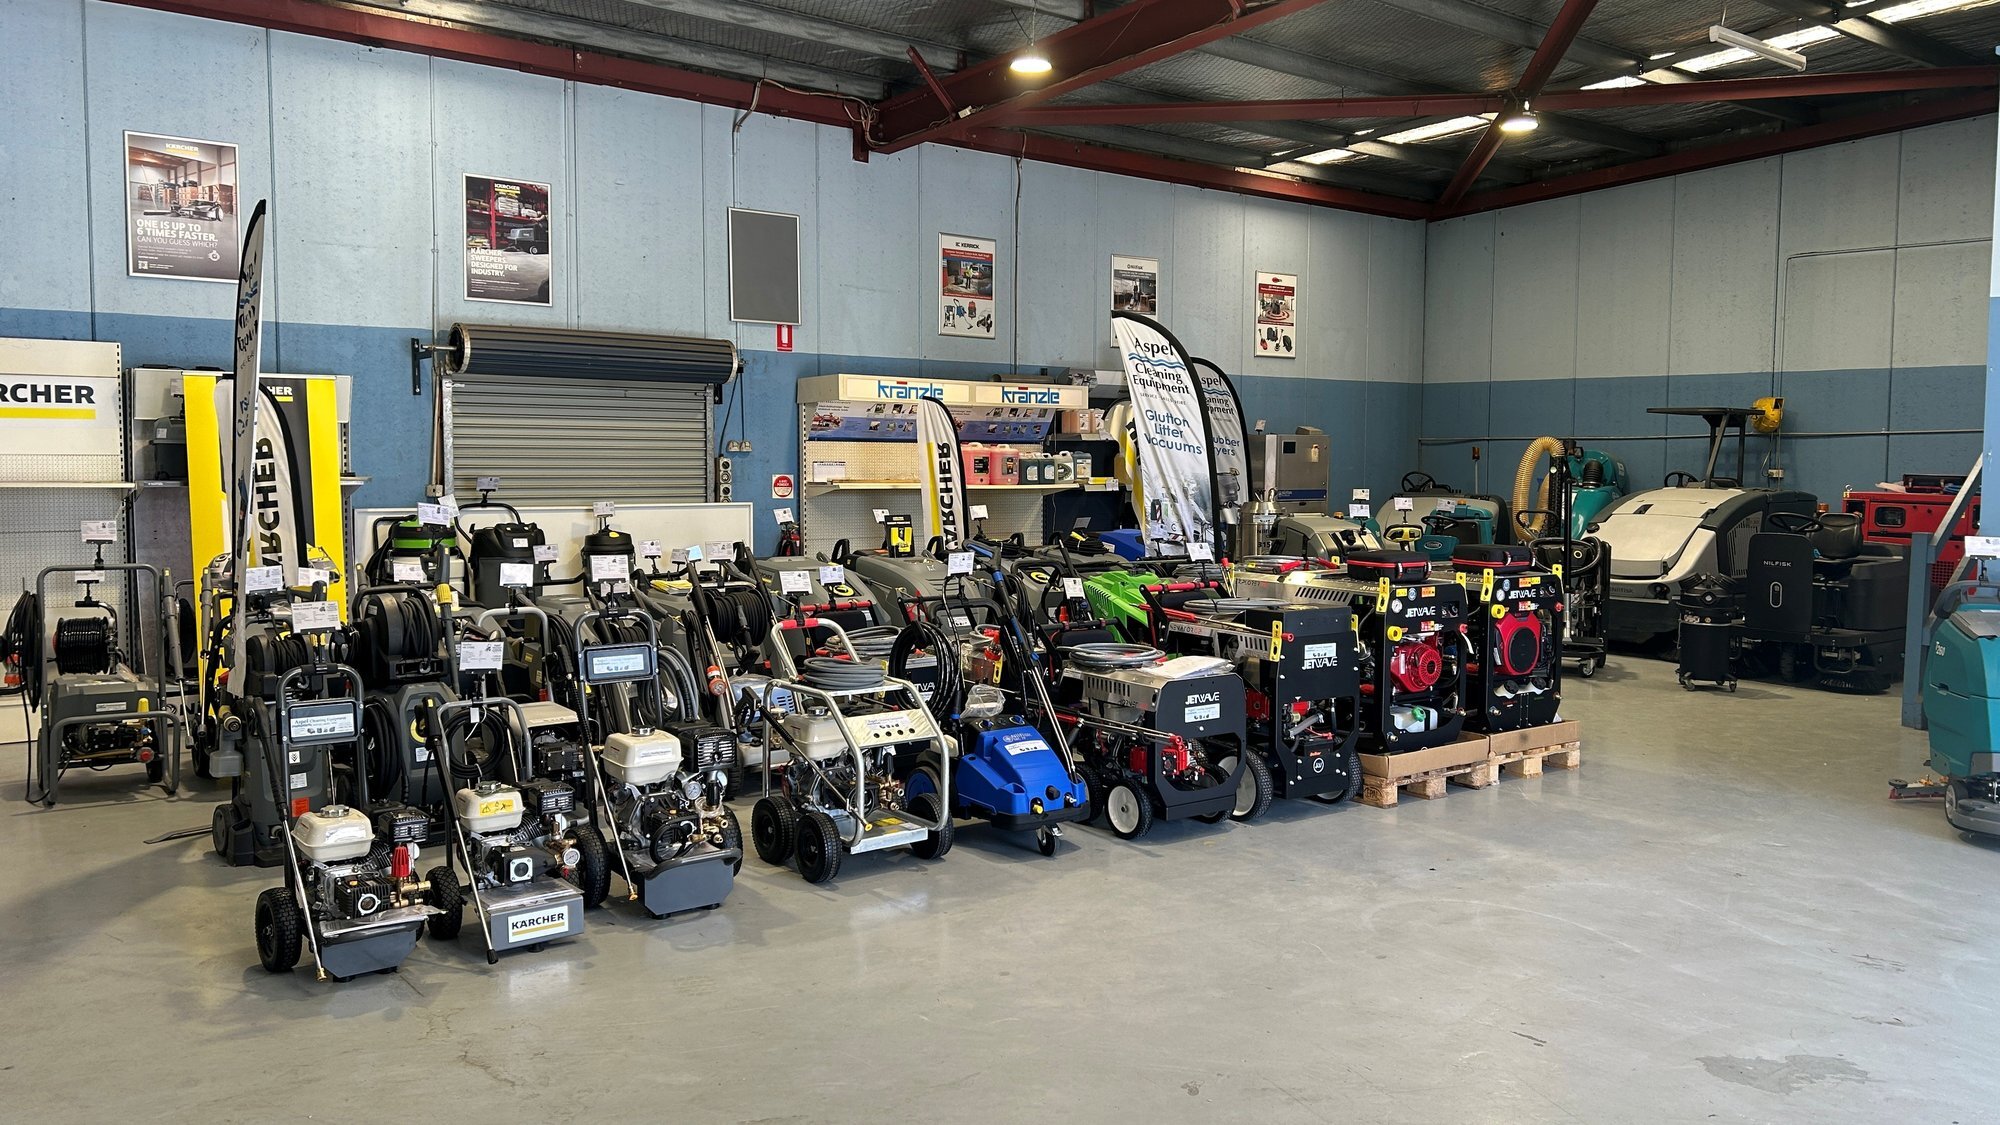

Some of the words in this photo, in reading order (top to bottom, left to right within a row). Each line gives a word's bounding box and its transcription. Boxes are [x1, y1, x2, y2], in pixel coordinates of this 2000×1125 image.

[136, 218, 159, 229] ONE
[160, 221, 171, 229] IS
[171, 222, 186, 231] UP
[188, 223, 201, 232] TO
[136, 227, 144, 236] 6
[146, 228, 177, 239] TIMES
[178, 230, 218, 242] FASTER.
[136, 235, 152, 244] CAN
[153, 237, 169, 245] YOU
[169, 238, 191, 247] GUESS
[192, 240, 218, 249] WHICH?
[470, 262, 504, 271] DESIGNED
[504, 264, 518, 272] FOR
[470, 268, 506, 278] INDUSTRY.
[1134, 337, 1175, 357] Aspel
[1135, 361, 1184, 385] Cleaning
[1132, 374, 1191, 395] Equipment
[1200, 376, 1223, 387] spel
[0, 382, 96, 405] RCHER
[1206, 396, 1230, 408] aning
[1144, 408, 1191, 428] Glutton
[1154, 423, 1184, 439] Litter
[1143, 432, 1203, 455] Vacuums
[1213, 436, 1240, 448] ubber
[1763, 560, 1792, 568] NILFISK
[1508, 588, 1537, 600] JETWAVE
[1405, 606, 1437, 619] JETWAVE
[1301, 656, 1338, 671] JETWAVE
[1184, 691, 1220, 706] JETWAVE
[511, 912, 565, 931] KÄRCHER
